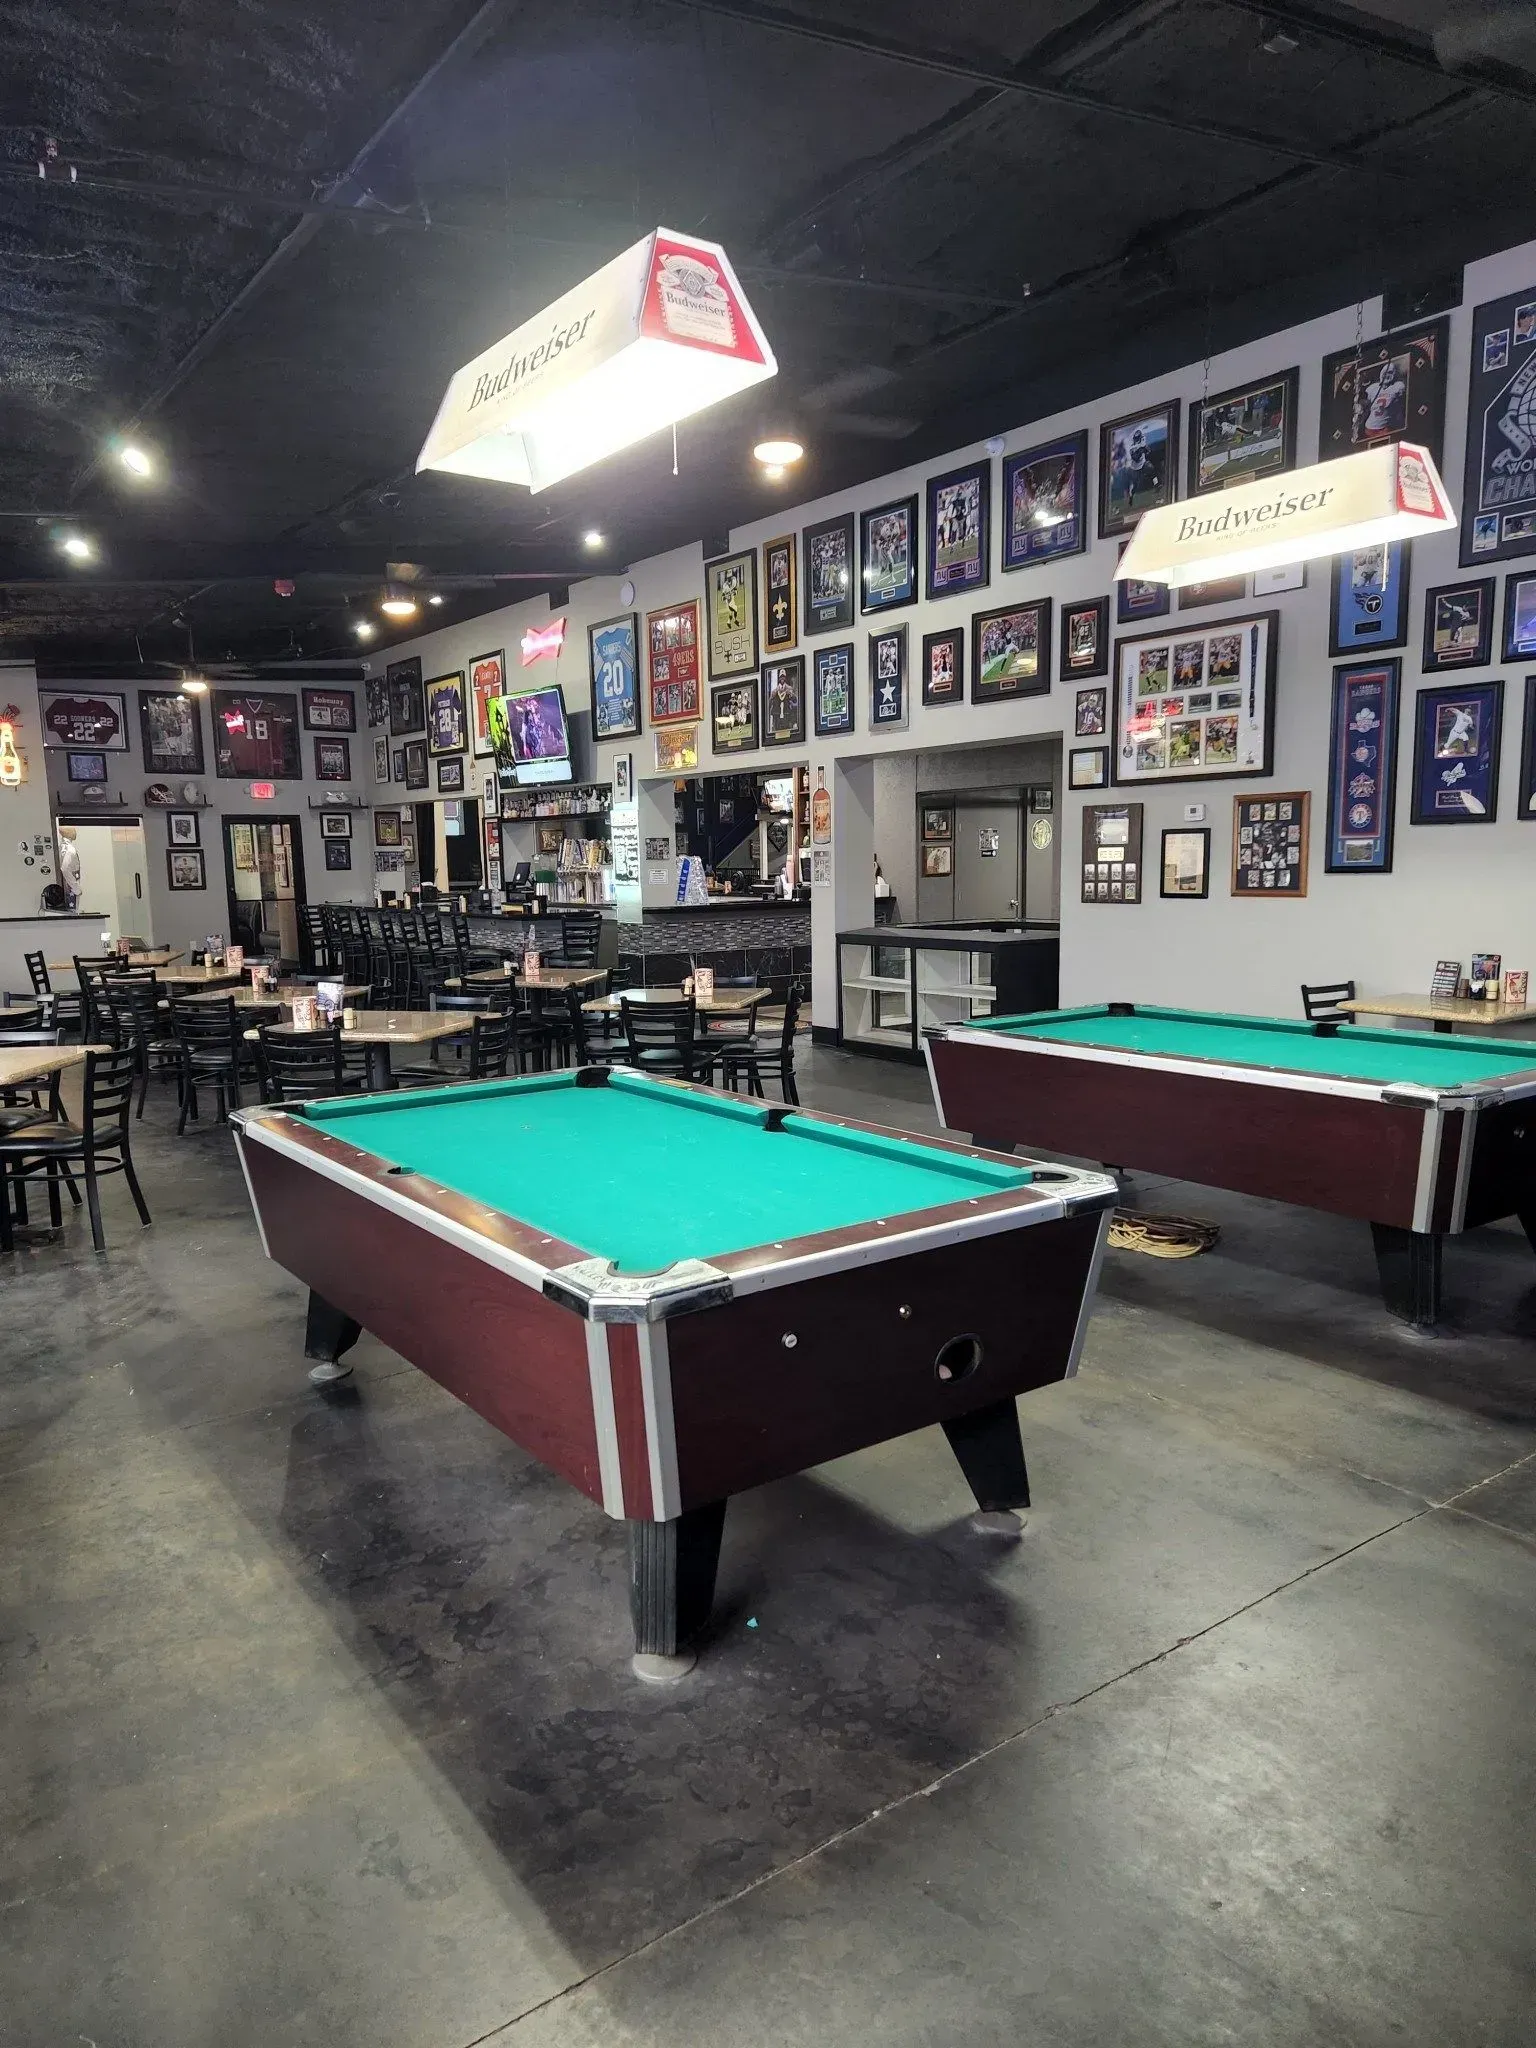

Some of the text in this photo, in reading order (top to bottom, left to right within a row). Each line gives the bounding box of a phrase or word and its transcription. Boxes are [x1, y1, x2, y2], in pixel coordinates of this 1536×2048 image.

[667, 291, 726, 317] Budweiser
[467, 309, 596, 413] Budweiser
[1507, 459, 1536, 475] WO
[1175, 487, 1335, 543] Budweiser
[715, 635, 751, 655] BUSH
[673, 650, 695, 667] 49ERS
[603, 660, 624, 698] 20
[54, 715, 68, 725] 22
[99, 716, 114, 727] 22
[245, 719, 269, 740] 18
[438, 708, 452, 732] 28
[73, 722, 96, 742] 22
